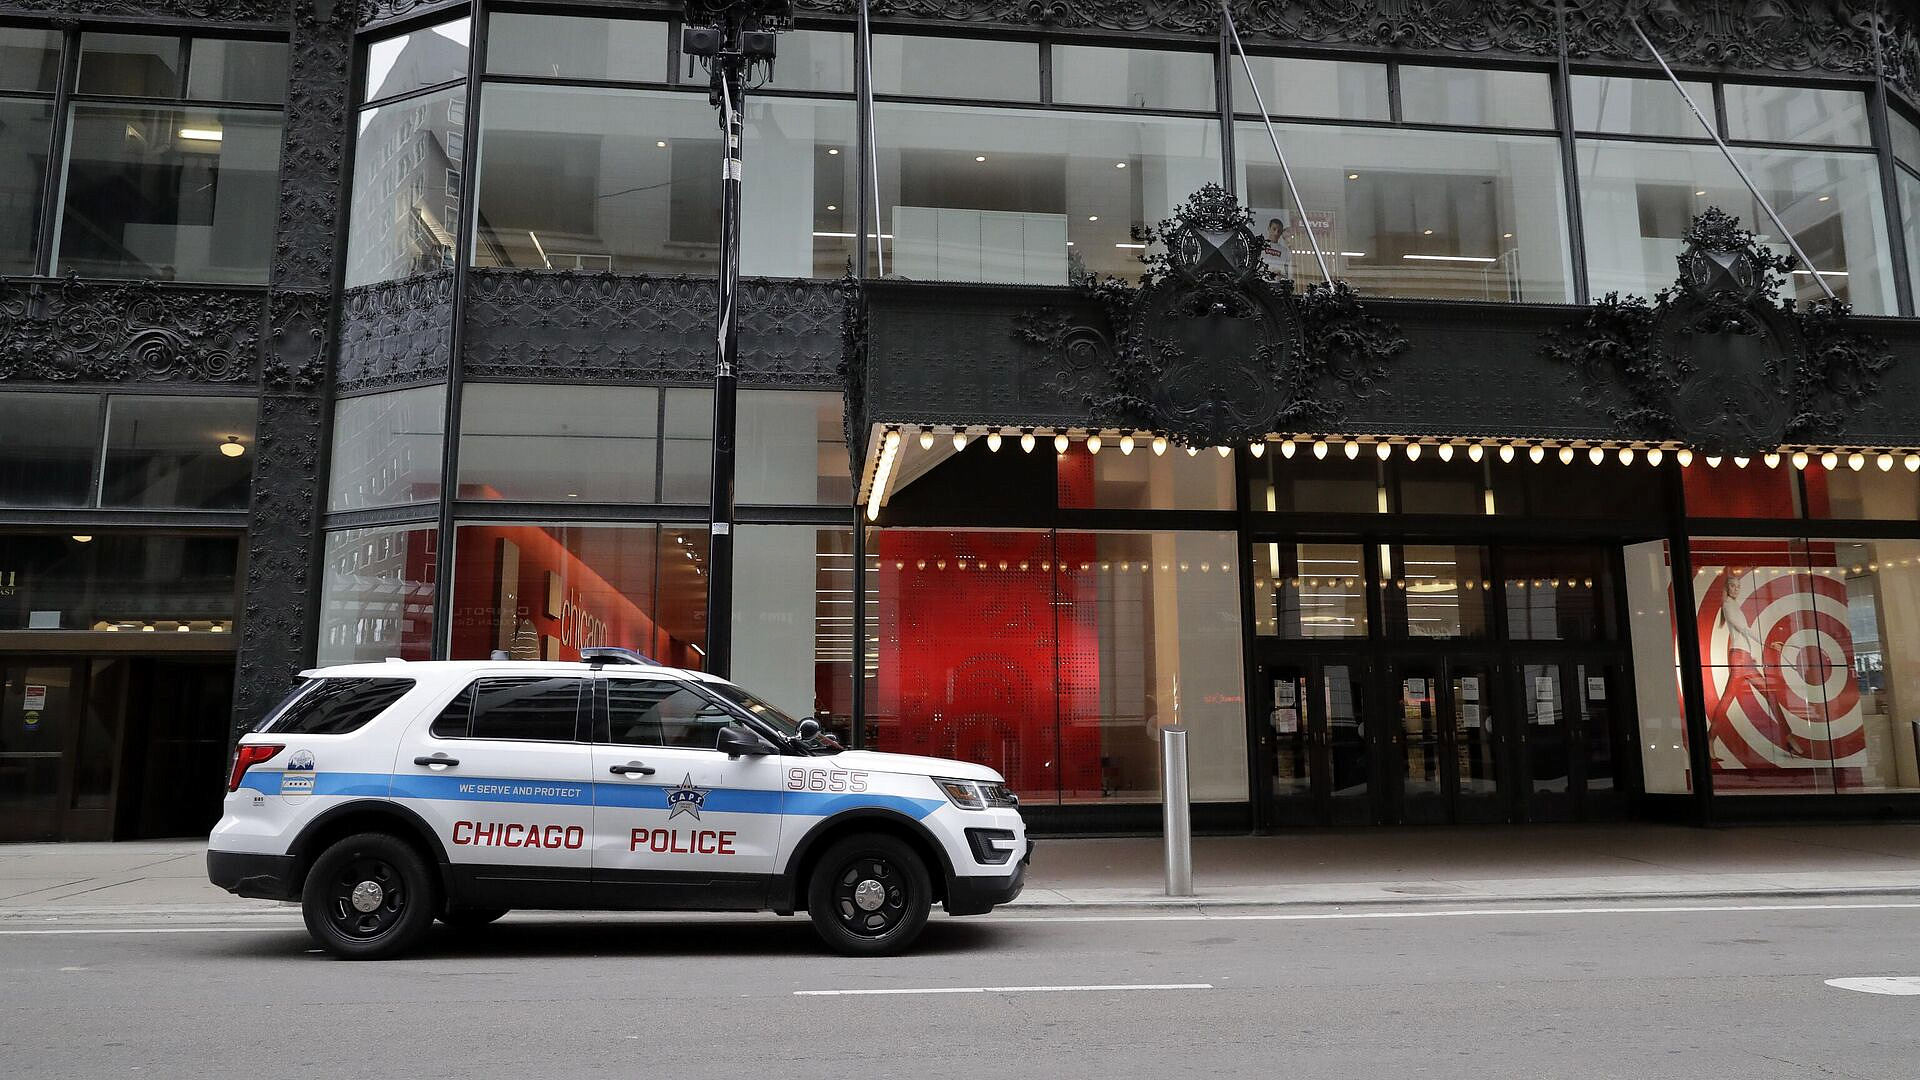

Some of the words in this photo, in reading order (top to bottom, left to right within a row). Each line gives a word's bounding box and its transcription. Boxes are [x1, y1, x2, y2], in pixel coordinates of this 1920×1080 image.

[459, 784, 475, 793] WE
[476, 785, 511, 795] SERVE
[512, 786, 533, 796] AND
[534, 788, 582, 798] PROTECT
[787, 767, 869, 793] 9655
[670, 793, 703, 803] CAPS
[452, 820, 584, 850] CHICAGO
[629, 828, 738, 855] POLICE
